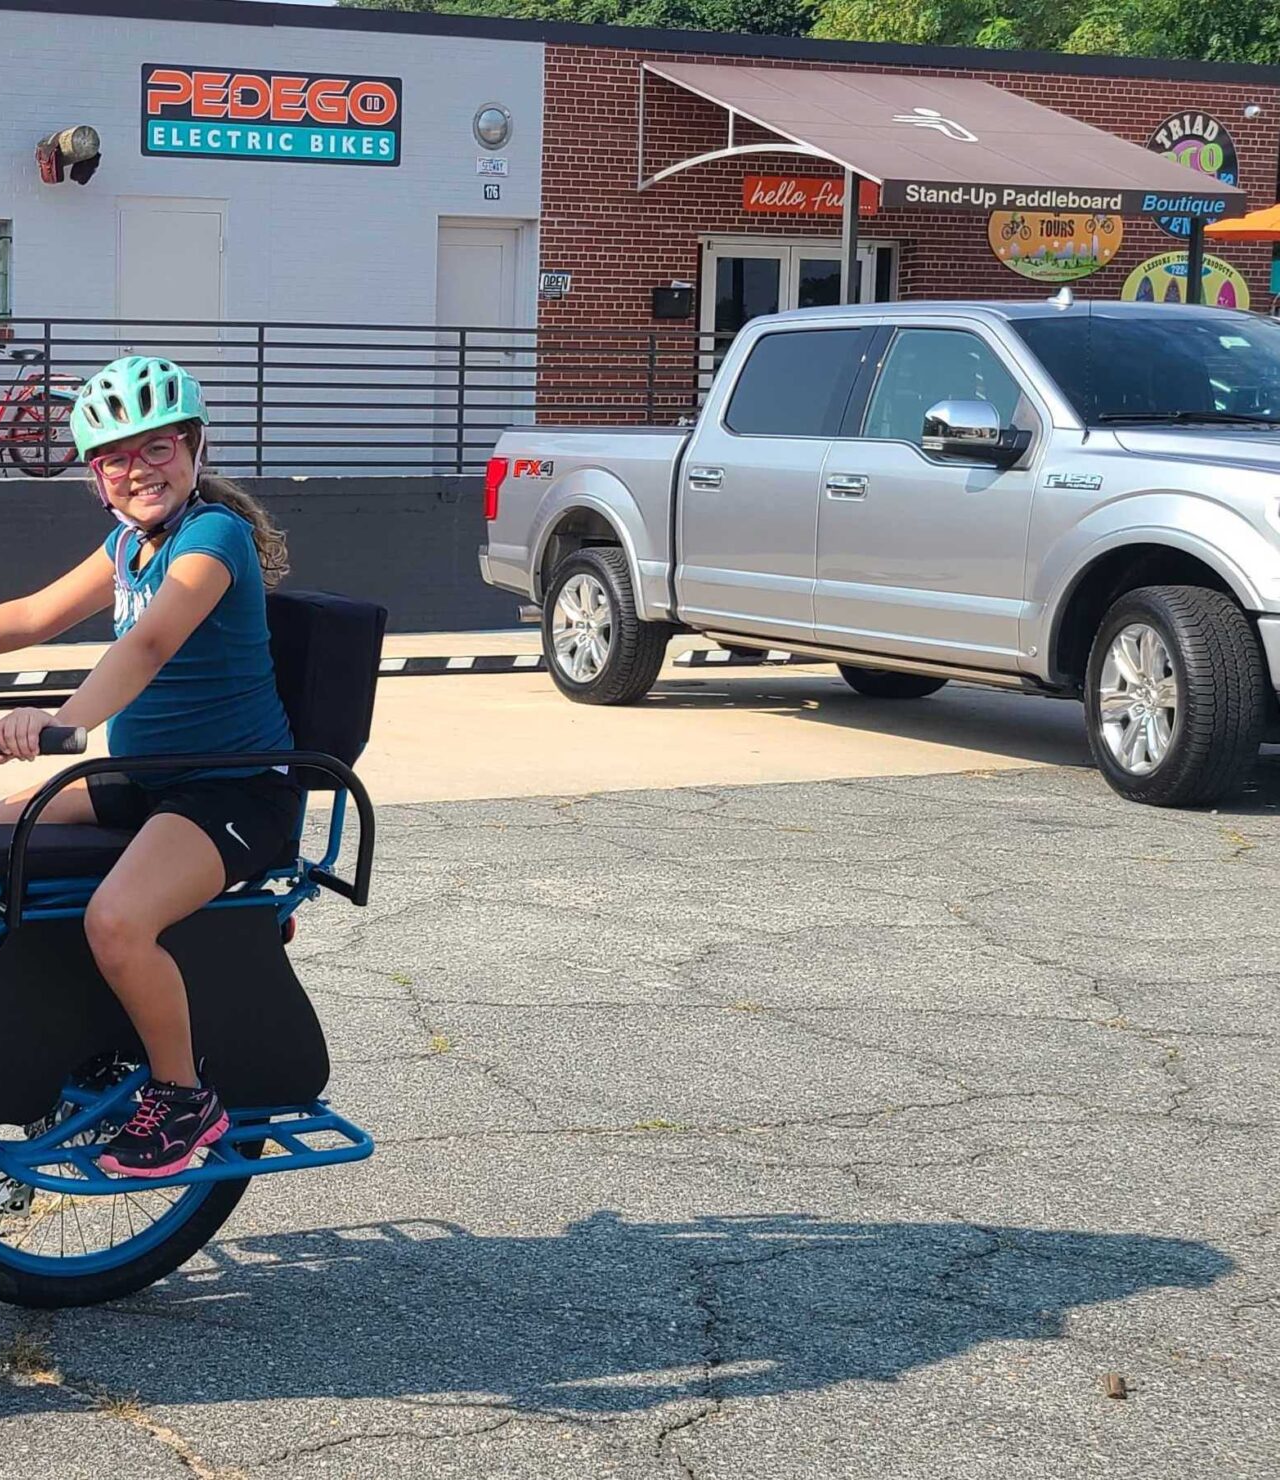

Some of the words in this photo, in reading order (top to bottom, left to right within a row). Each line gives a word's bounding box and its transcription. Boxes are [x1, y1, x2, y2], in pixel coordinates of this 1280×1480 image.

[147, 69, 397, 125] PEDEGO
[153, 126, 294, 152] ELECTRIC
[310, 134, 390, 156] BIKES
[1155, 114, 1218, 149] TRIAD
[485, 185, 499, 199] 176
[750, 180, 807, 210] hello,
[905, 184, 997, 209] Stand-Up
[1002, 189, 1122, 211] Paddleboard
[1142, 195, 1226, 216] Boutique
[1039, 219, 1075, 238] TOURS
[543, 274, 570, 290] OPEN
[513, 459, 554, 478] FX4
